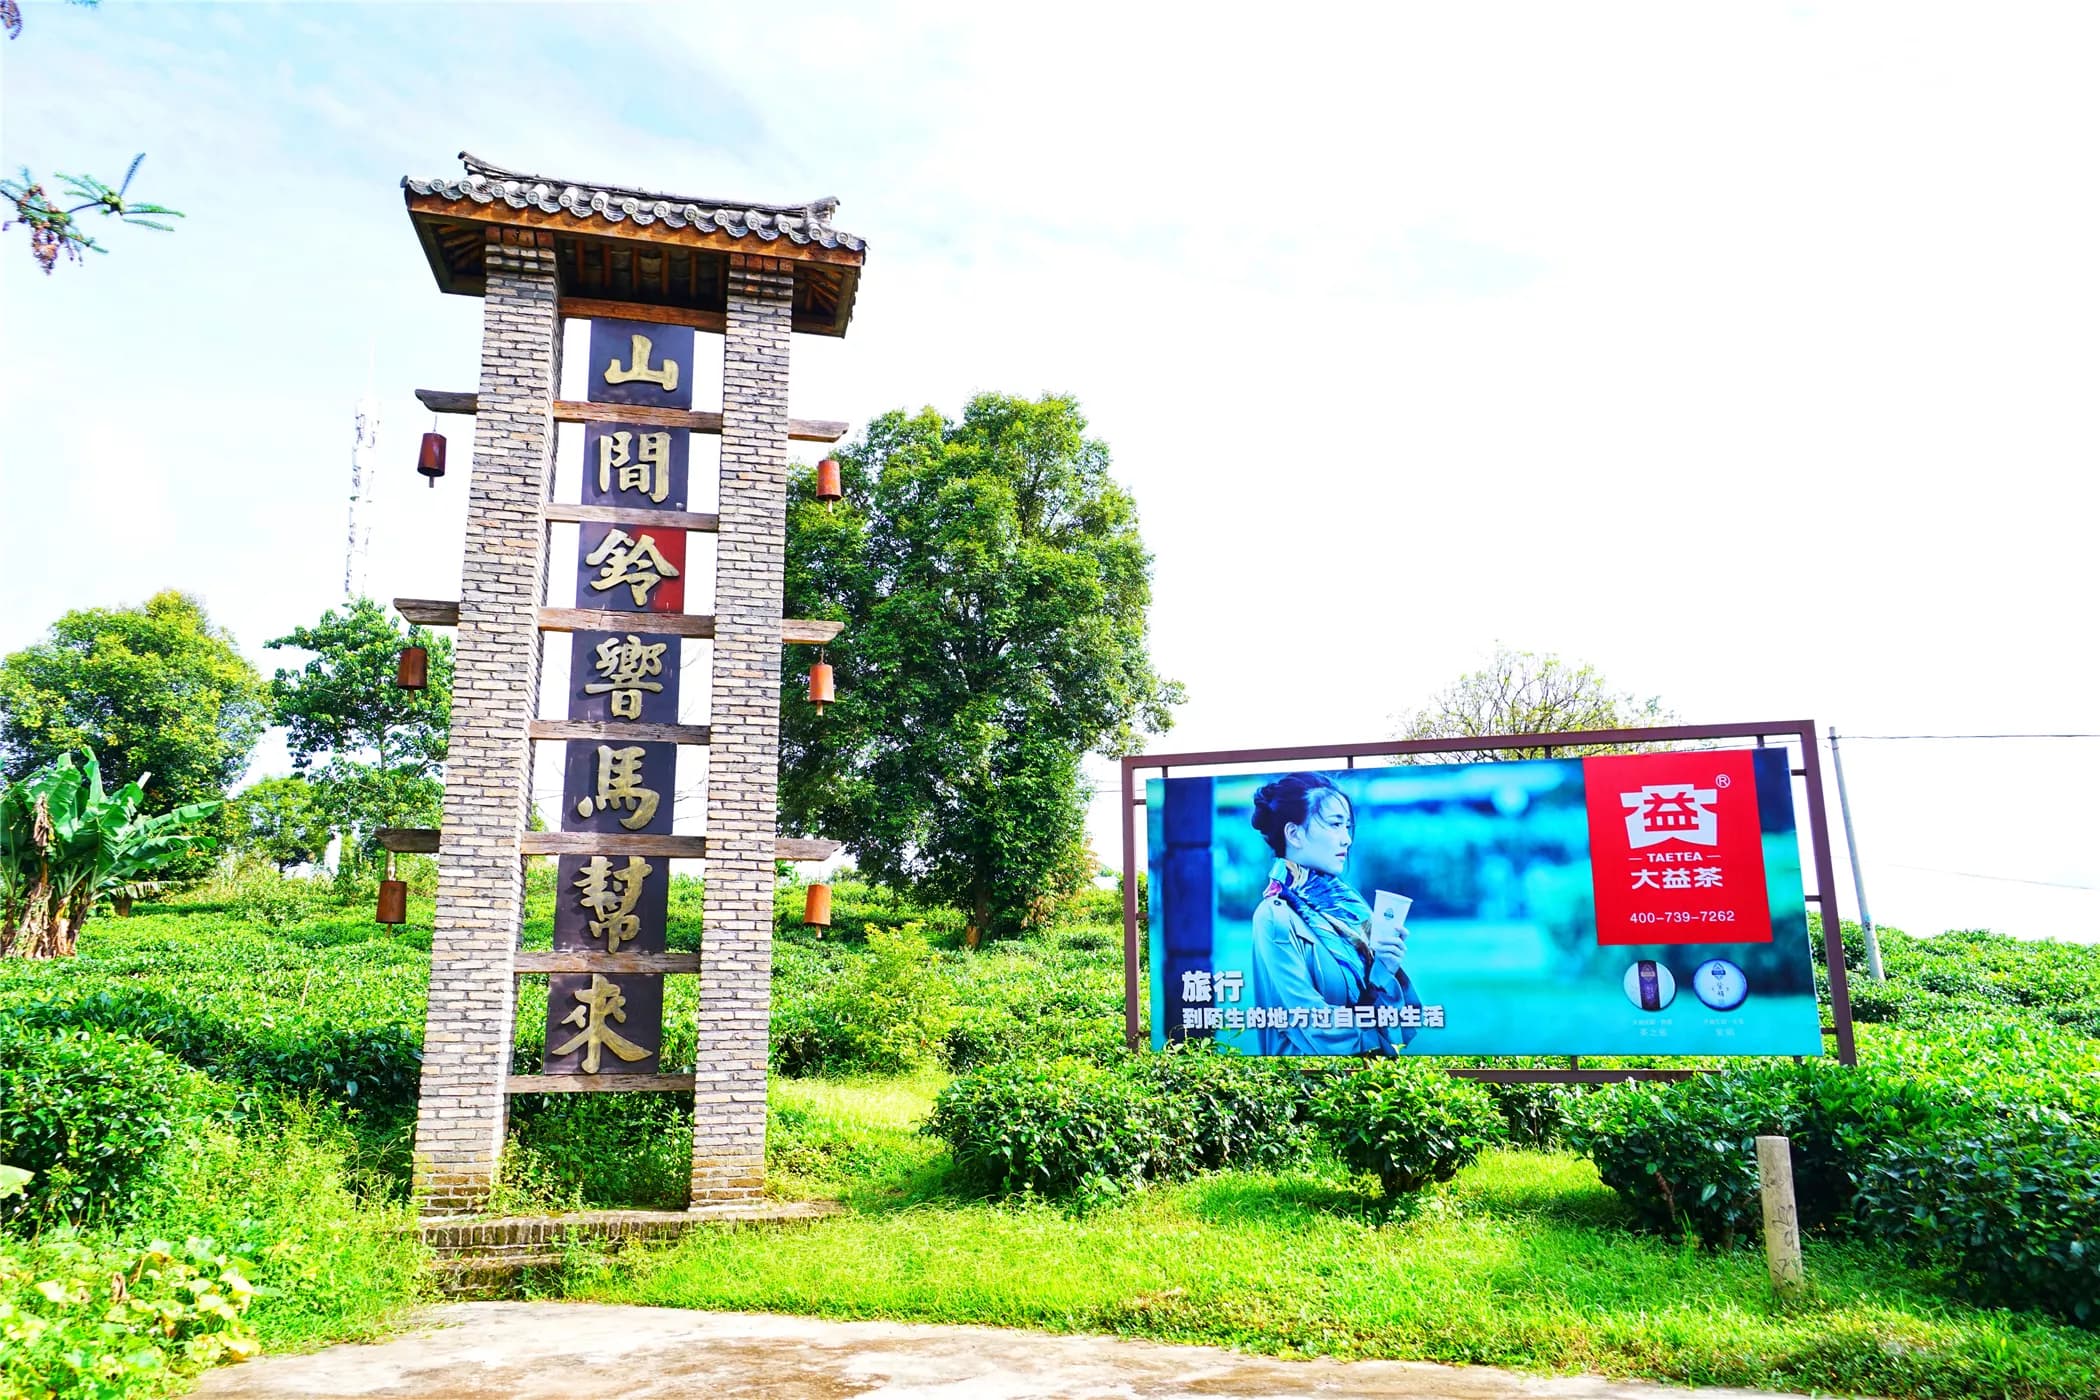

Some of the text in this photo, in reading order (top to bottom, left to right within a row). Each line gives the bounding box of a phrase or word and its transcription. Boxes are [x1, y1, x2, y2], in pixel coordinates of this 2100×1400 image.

[1646, 851, 1704, 863] TAETEA
[1630, 866, 1724, 890] 大益茶
[1629, 910, 1736, 924] 400-739-7262
[1181, 970, 1244, 1003] 旅行
[1181, 1004, 1445, 1030] 到陌生的地方过自己的生活
